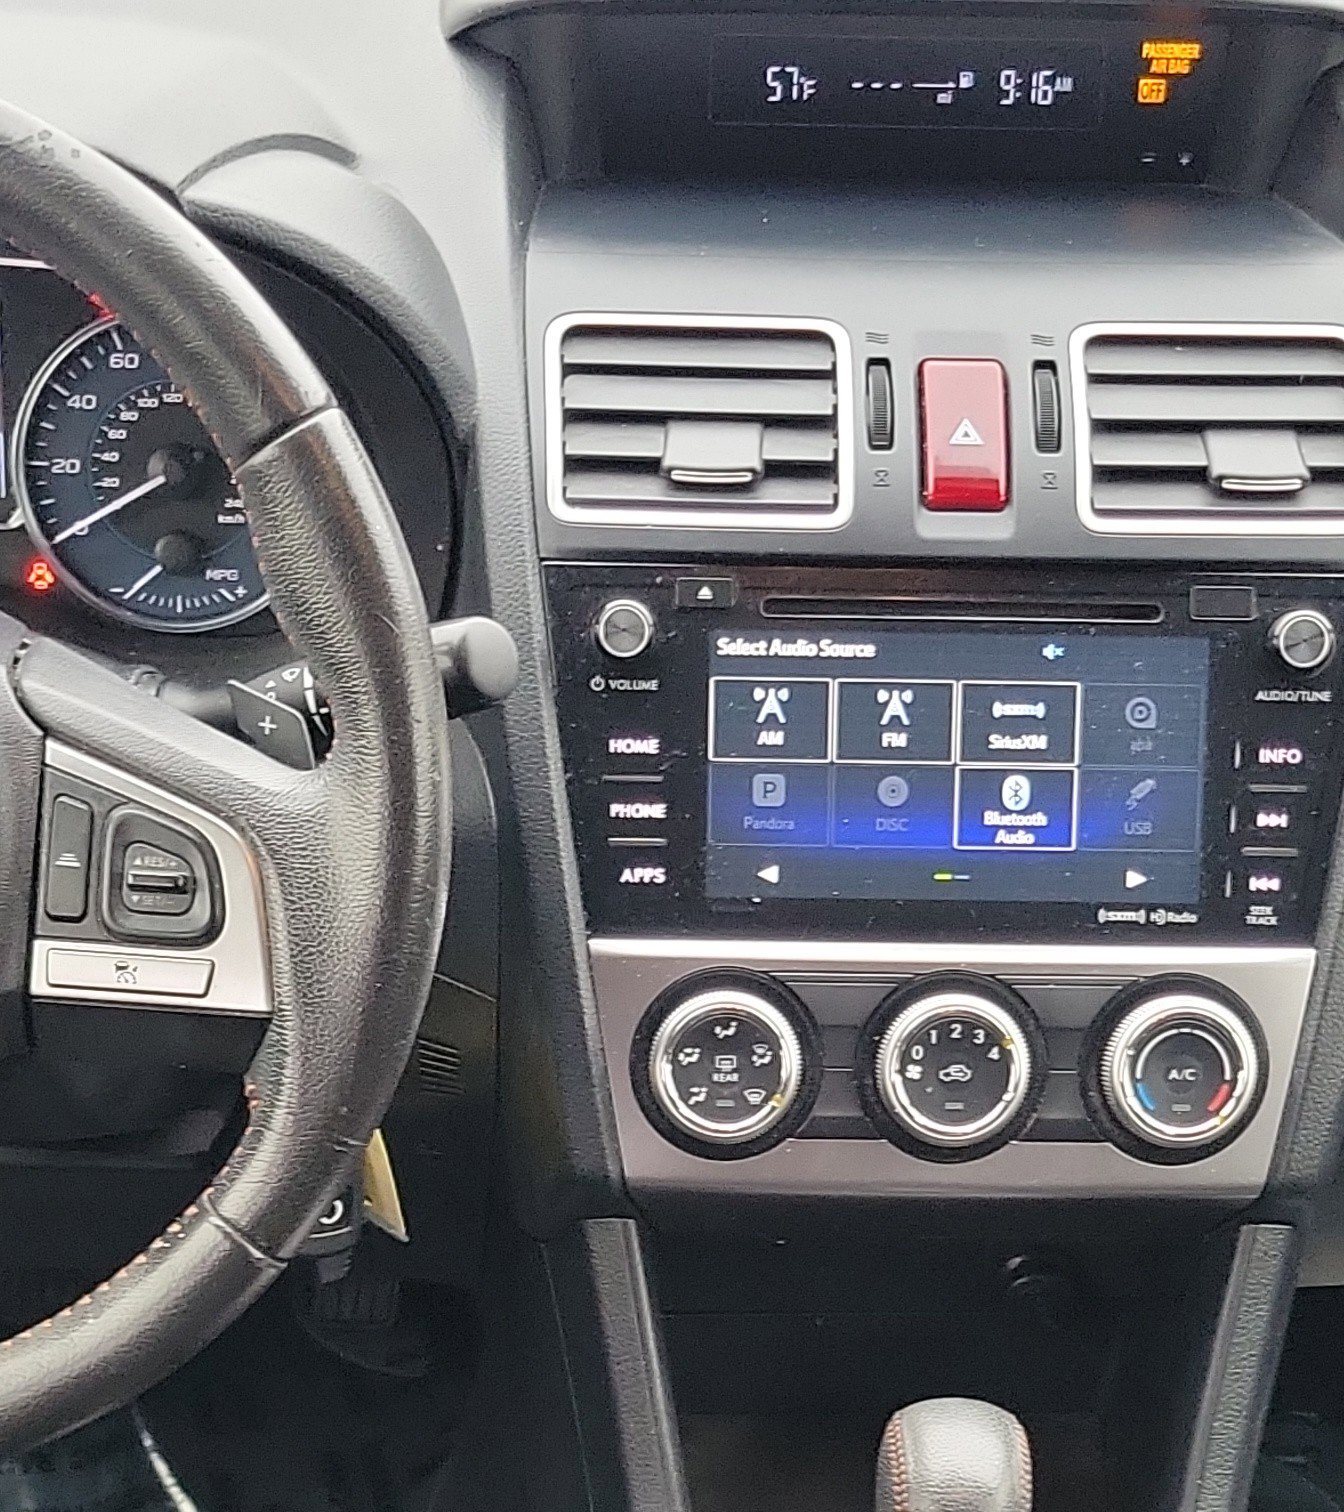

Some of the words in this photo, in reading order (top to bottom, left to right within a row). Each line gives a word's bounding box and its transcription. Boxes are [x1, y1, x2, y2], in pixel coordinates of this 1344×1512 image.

[999, 69, 1055, 105] 9:16
[1140, 81, 1165, 101] OFF
[109, 353, 139, 369] 60
[66, 393, 97, 410] 40
[137, 398, 159, 408] 100
[162, 393, 183, 403] 120
[119, 410, 139, 421] 80
[107, 429, 127, 440] 60
[100, 452, 120, 462] 40
[50, 458, 81, 474] 20
[206, 569, 239, 581] MPG
[716, 638, 768, 656] Select
[769, 638, 818, 657] Audio
[819, 639, 877, 658] Source
[608, 679, 659, 691] VOLUME
[1255, 690, 1332, 703] AUDIO/TUNE
[608, 739, 661, 754] HOME
[757, 732, 784, 746] AM
[881, 732, 907, 748] FM
[988, 734, 1048, 749] SiriusXM
[1258, 748, 1303, 765] INFO
[609, 804, 668, 819] PHONE
[983, 811, 1048, 827] Bluetooth
[743, 816, 795, 831] Pandora
[875, 818, 909, 832] DISC
[1124, 822, 1152, 836] USB
[994, 830, 1035, 845] Audio
[619, 868, 667, 883] APPS
[1167, 911, 1198, 924] Radio
[929, 1029, 939, 1044] 1
[949, 1023, 962, 1039] 2
[972, 1029, 985, 1044] 3
[911, 1045, 924, 1060] 0
[986, 1046, 1001, 1060] 4
[712, 1073, 739, 1082] REAR
[1167, 1067, 1196, 1082] A/C
